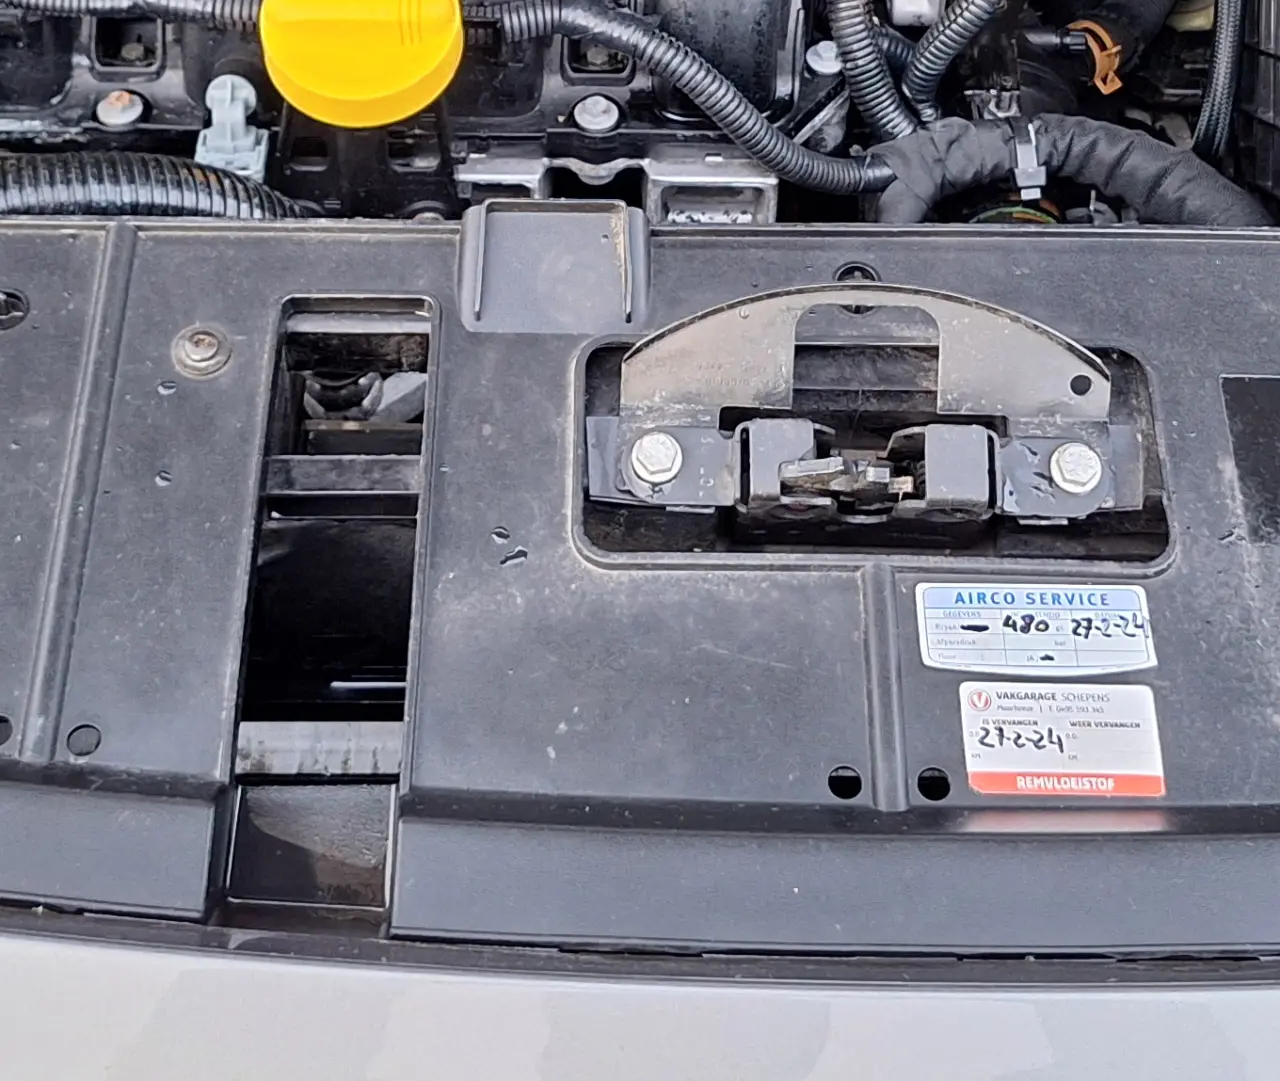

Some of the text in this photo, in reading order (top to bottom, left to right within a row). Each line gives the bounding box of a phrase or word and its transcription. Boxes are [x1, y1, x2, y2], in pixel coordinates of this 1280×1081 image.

[954, 591, 1110, 606] AIRCO SERVICE
[1002, 614, 1050, 634] 480
[995, 691, 1057, 701] VAKGARAGE
[1061, 693, 1111, 703] SCHEPENS
[978, 726, 1065, 753] 27-2-24
[1015, 775, 1116, 791] REMVLOEISTOF
